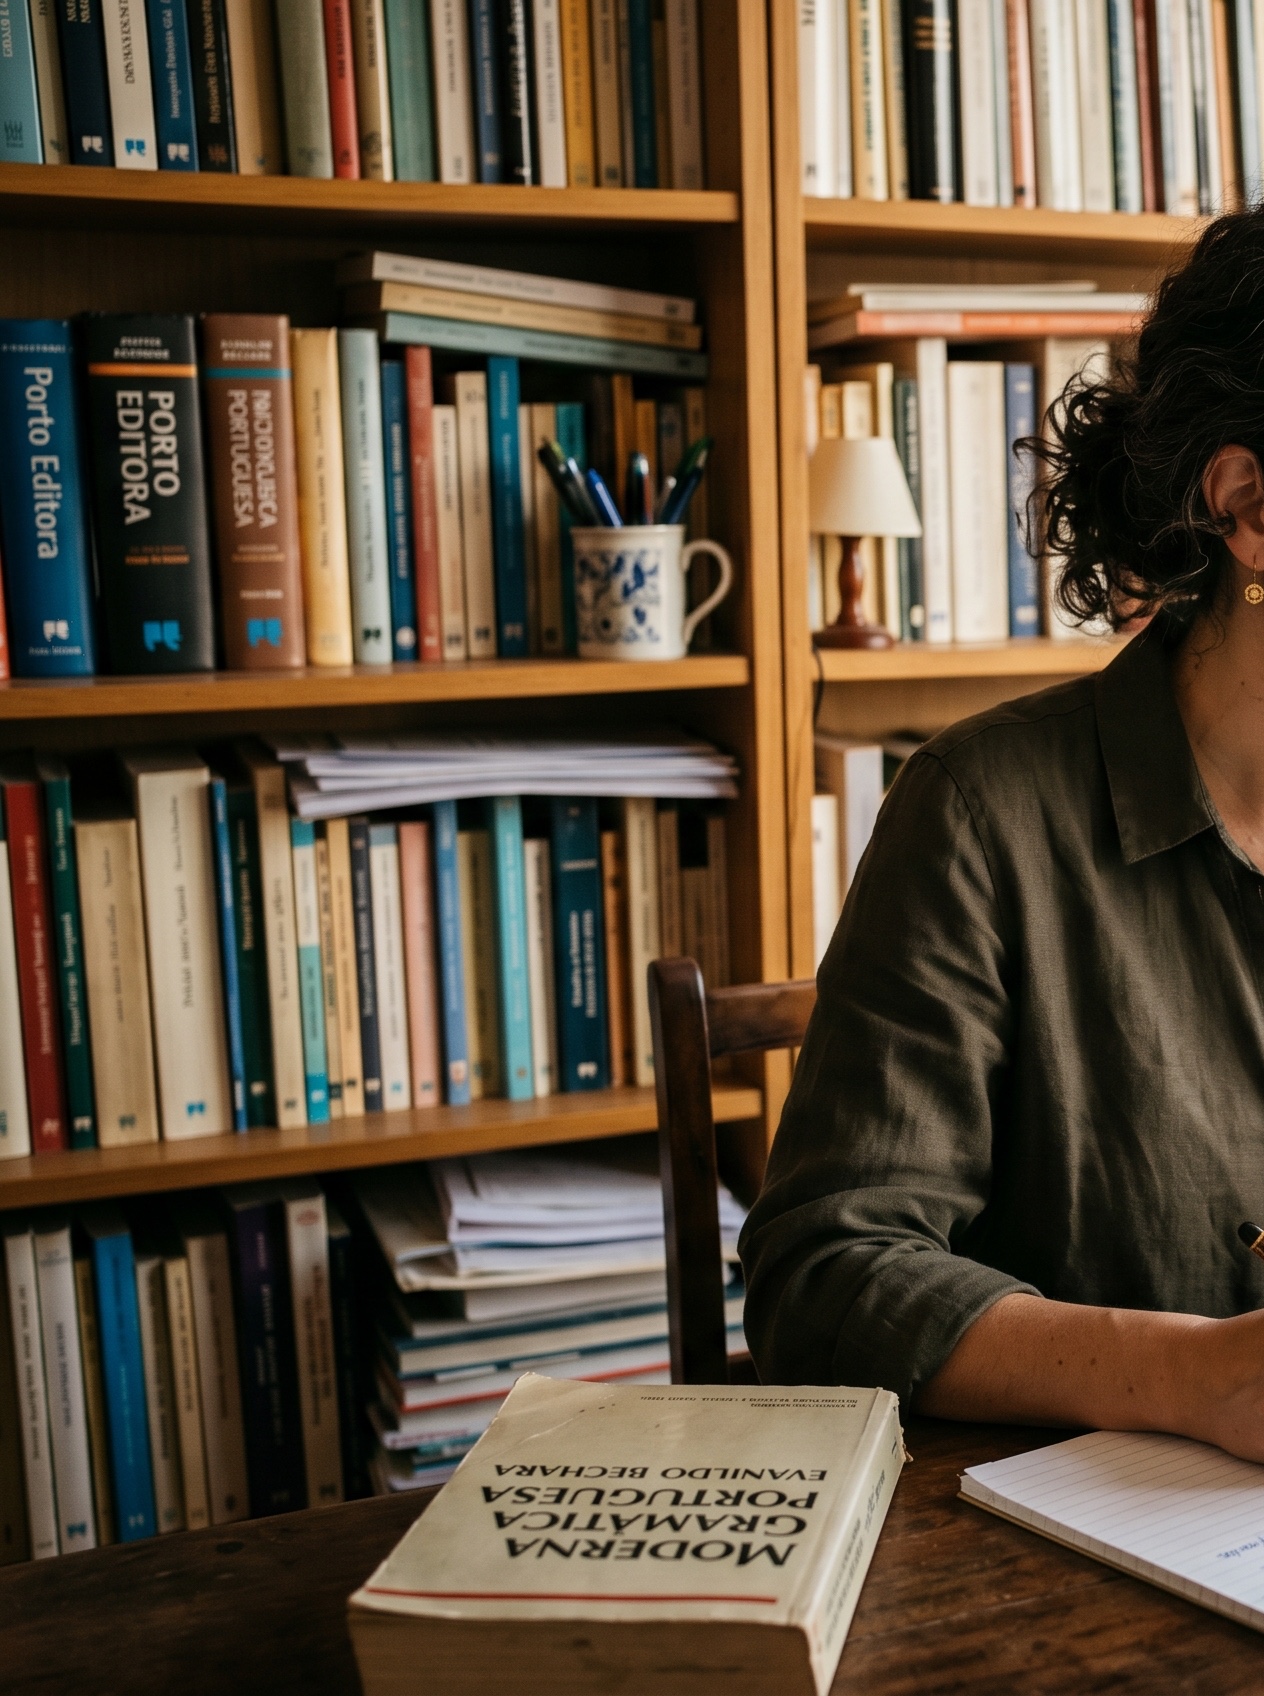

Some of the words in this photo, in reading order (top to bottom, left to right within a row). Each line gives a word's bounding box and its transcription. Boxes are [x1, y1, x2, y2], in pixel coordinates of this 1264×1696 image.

[24, 367, 55, 447] Porto
[148, 390, 181, 498] PORTO
[116, 390, 151, 526] EDITORA
[227, 389, 255, 529] PORTUGUESA
[31, 455, 62, 559] Editora
[481, 1486, 819, 1509] PORTUGUESA
[494, 1464, 649, 1479] BECHARA
[660, 1466, 828, 1482] EVANILDO
